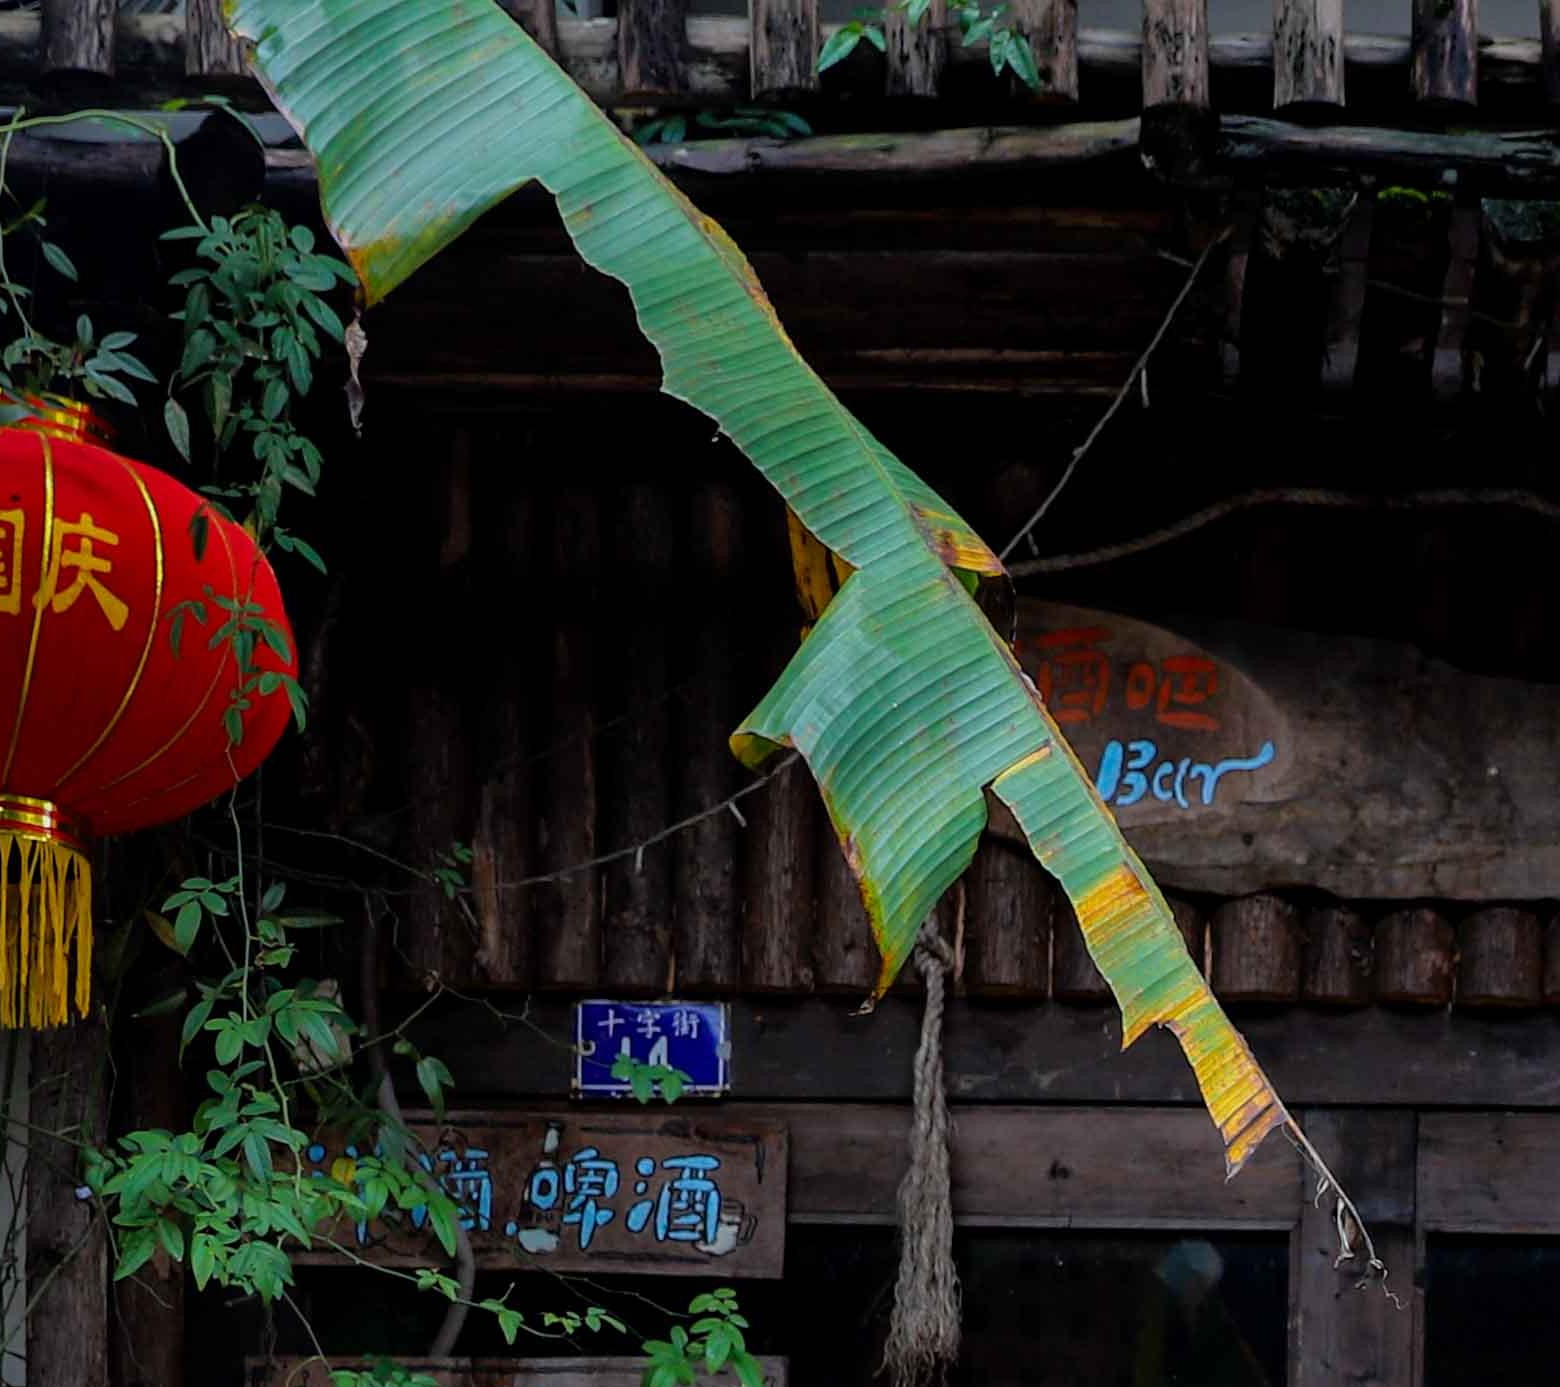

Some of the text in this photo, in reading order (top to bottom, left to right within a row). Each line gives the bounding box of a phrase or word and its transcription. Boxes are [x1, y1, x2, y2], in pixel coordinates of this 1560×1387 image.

[1094, 737, 1278, 810] Bar
[596, 1007, 701, 1041] 十字街
